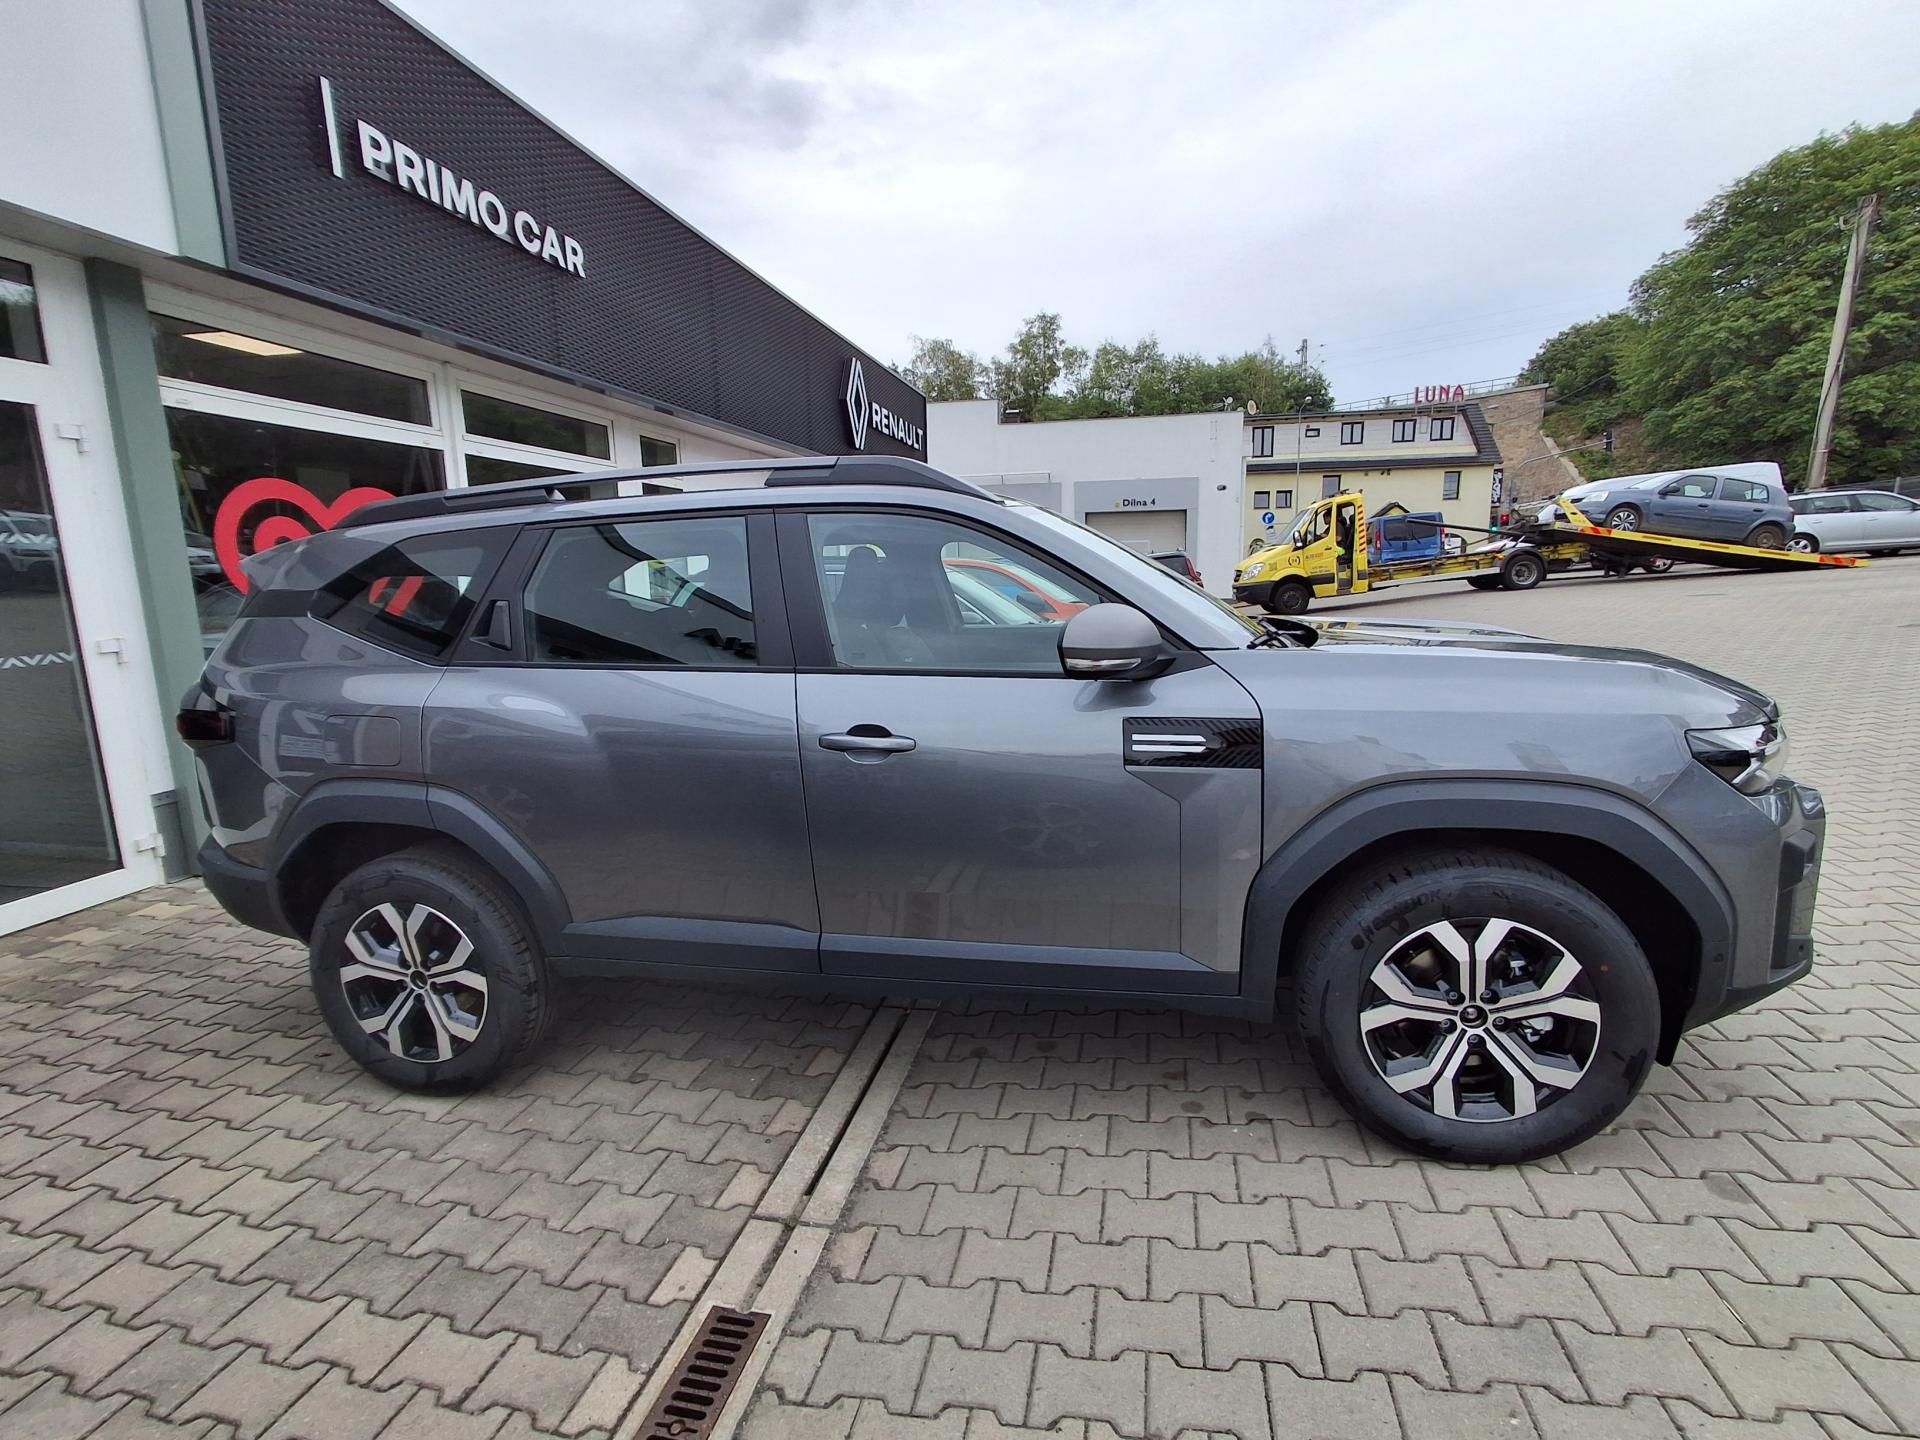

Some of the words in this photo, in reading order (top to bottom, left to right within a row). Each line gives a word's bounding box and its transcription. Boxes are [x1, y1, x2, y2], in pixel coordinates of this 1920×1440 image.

[357, 118, 510, 238] PRIMO
[513, 210, 587, 279] CAR
[1414, 384, 1465, 404] LUNA
[872, 401, 924, 451] RENAULT
[1150, 498, 1156, 506] 4
